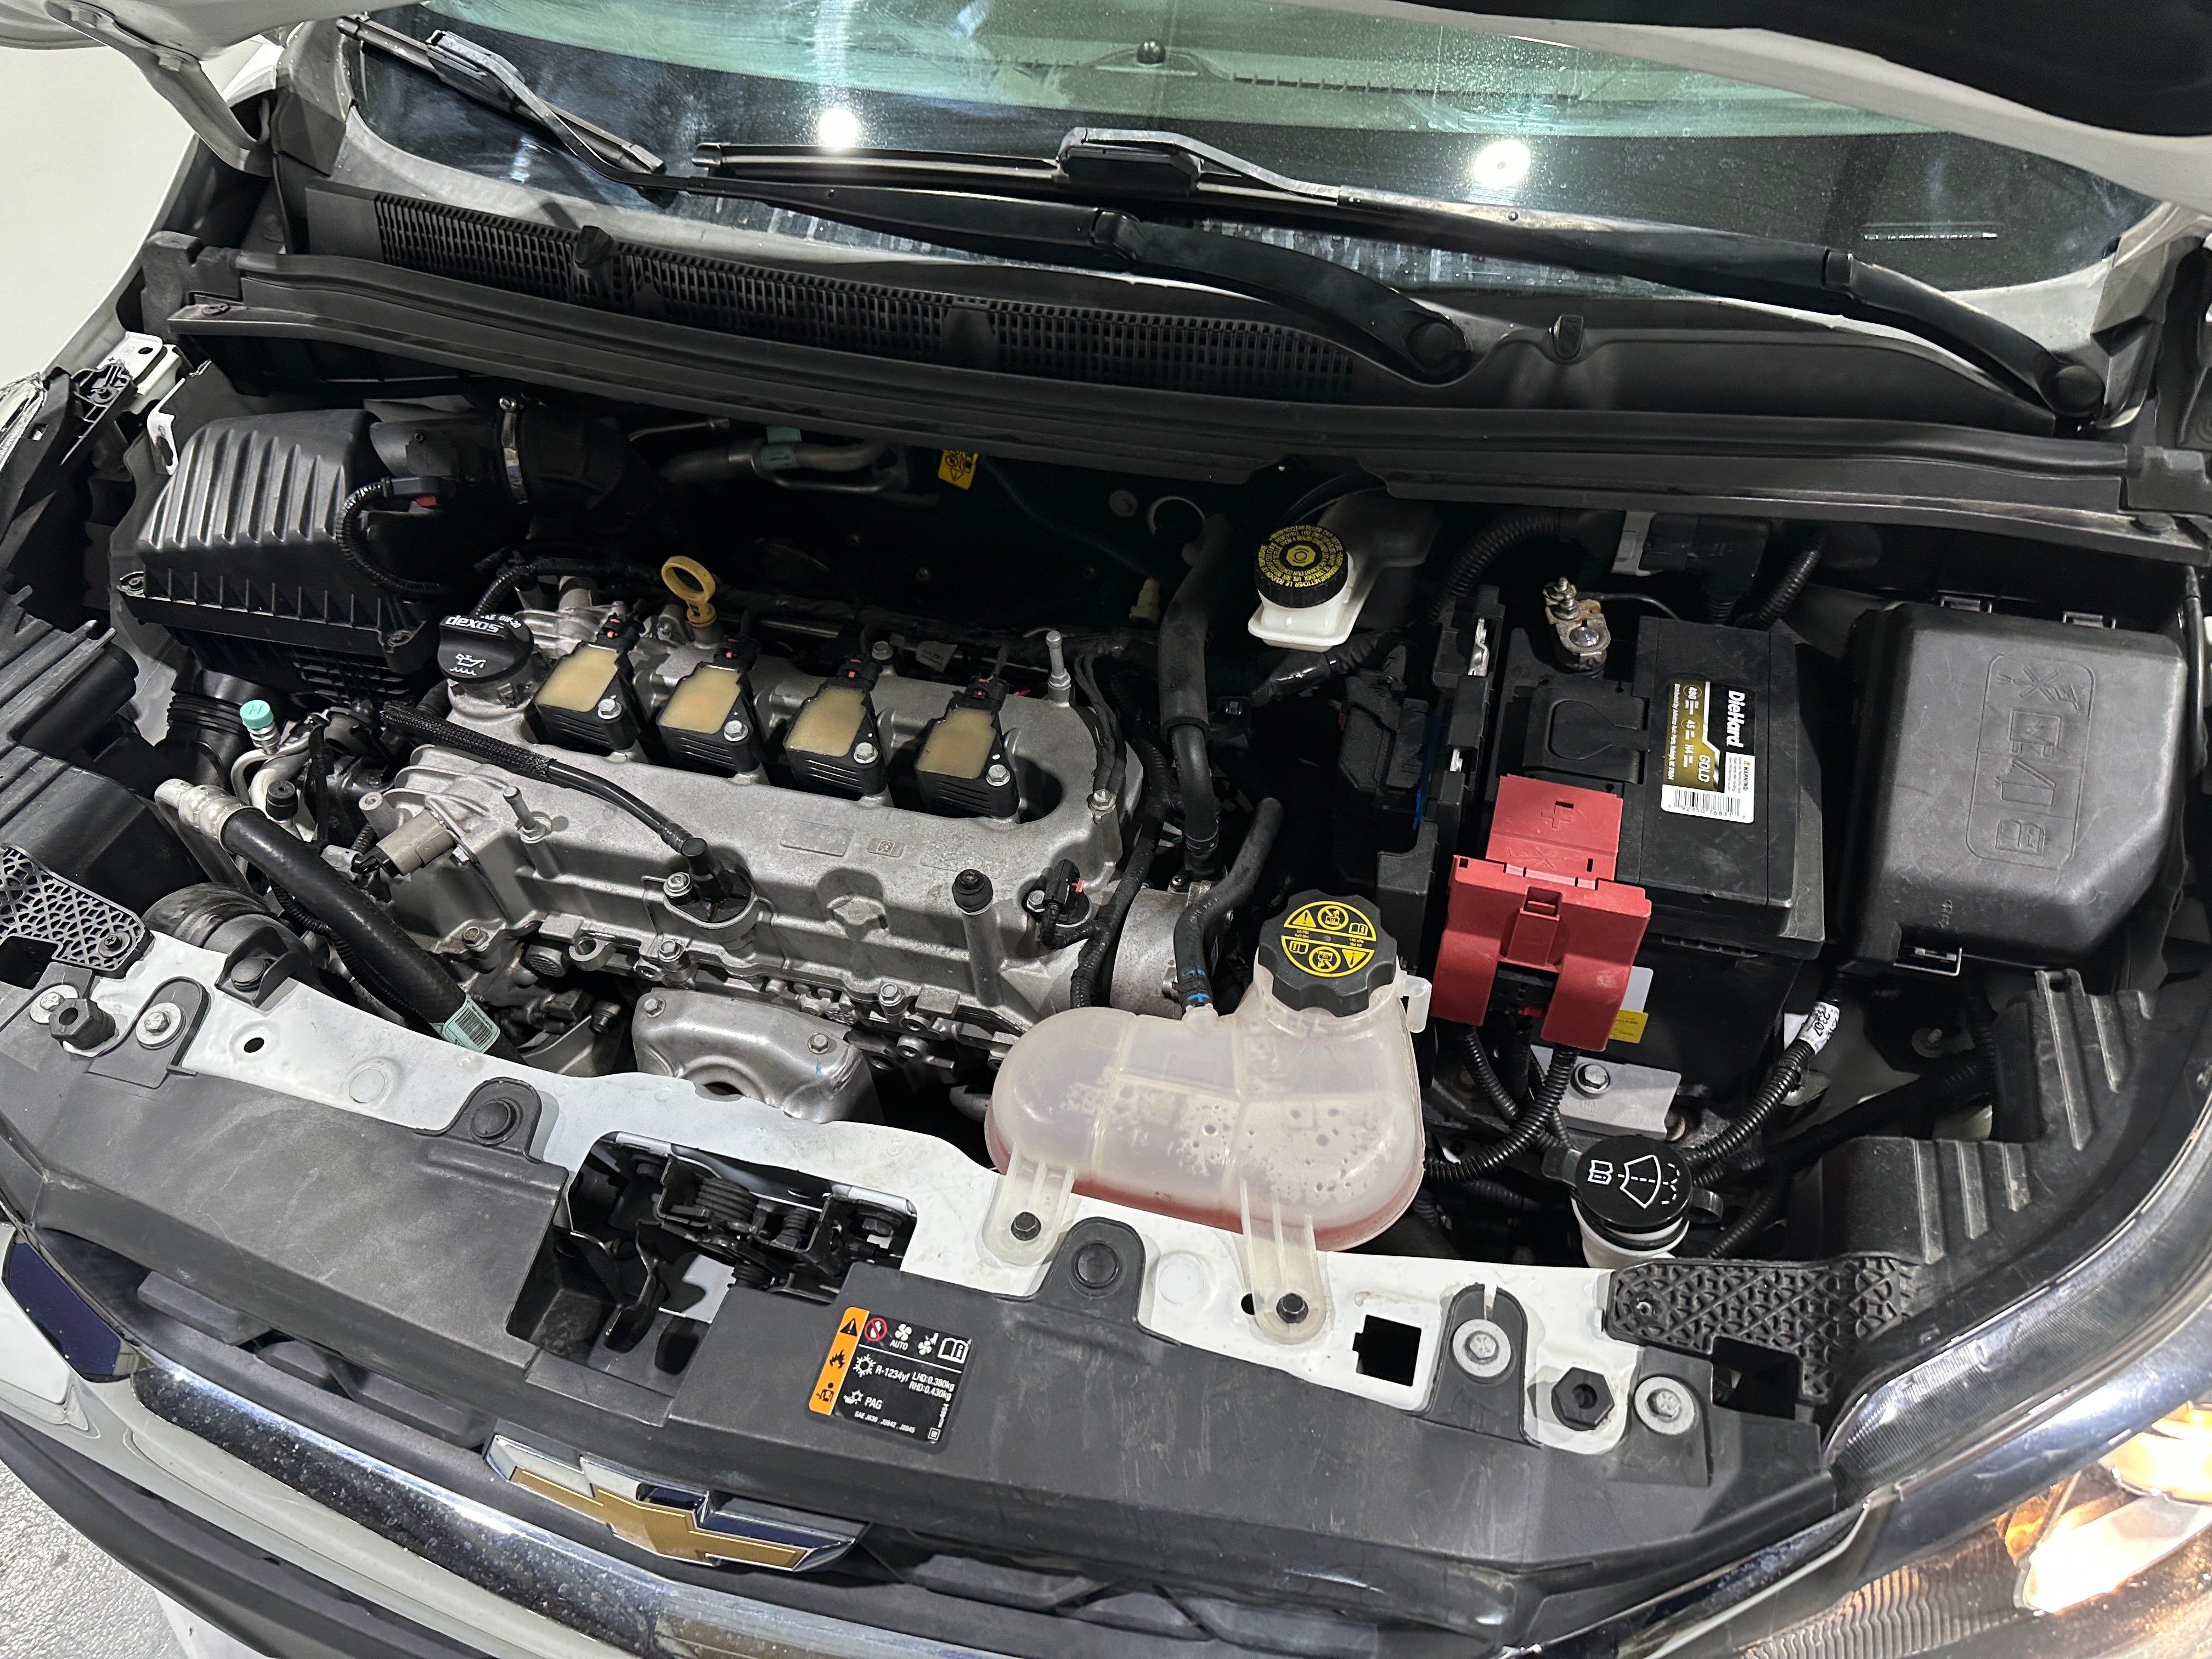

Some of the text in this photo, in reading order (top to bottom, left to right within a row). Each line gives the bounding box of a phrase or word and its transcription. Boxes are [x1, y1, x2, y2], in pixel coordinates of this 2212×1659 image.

[1322, 529, 1333, 538] CAP
[445, 614, 505, 633] dexos
[1688, 686, 1697, 700] 480
[1686, 719, 1695, 729] 45
[1725, 690, 1745, 748] DieHard
[1684, 744, 1694, 754] H4
[1697, 754, 1711, 782] GOLD
[889, 1340, 909, 1351] AUTO
[874, 1365, 955, 1392] R-1234yf LHD:0.380kg
[909, 1381, 952, 1402] RHD:0.430kg
[864, 1396, 883, 1410] PAG
